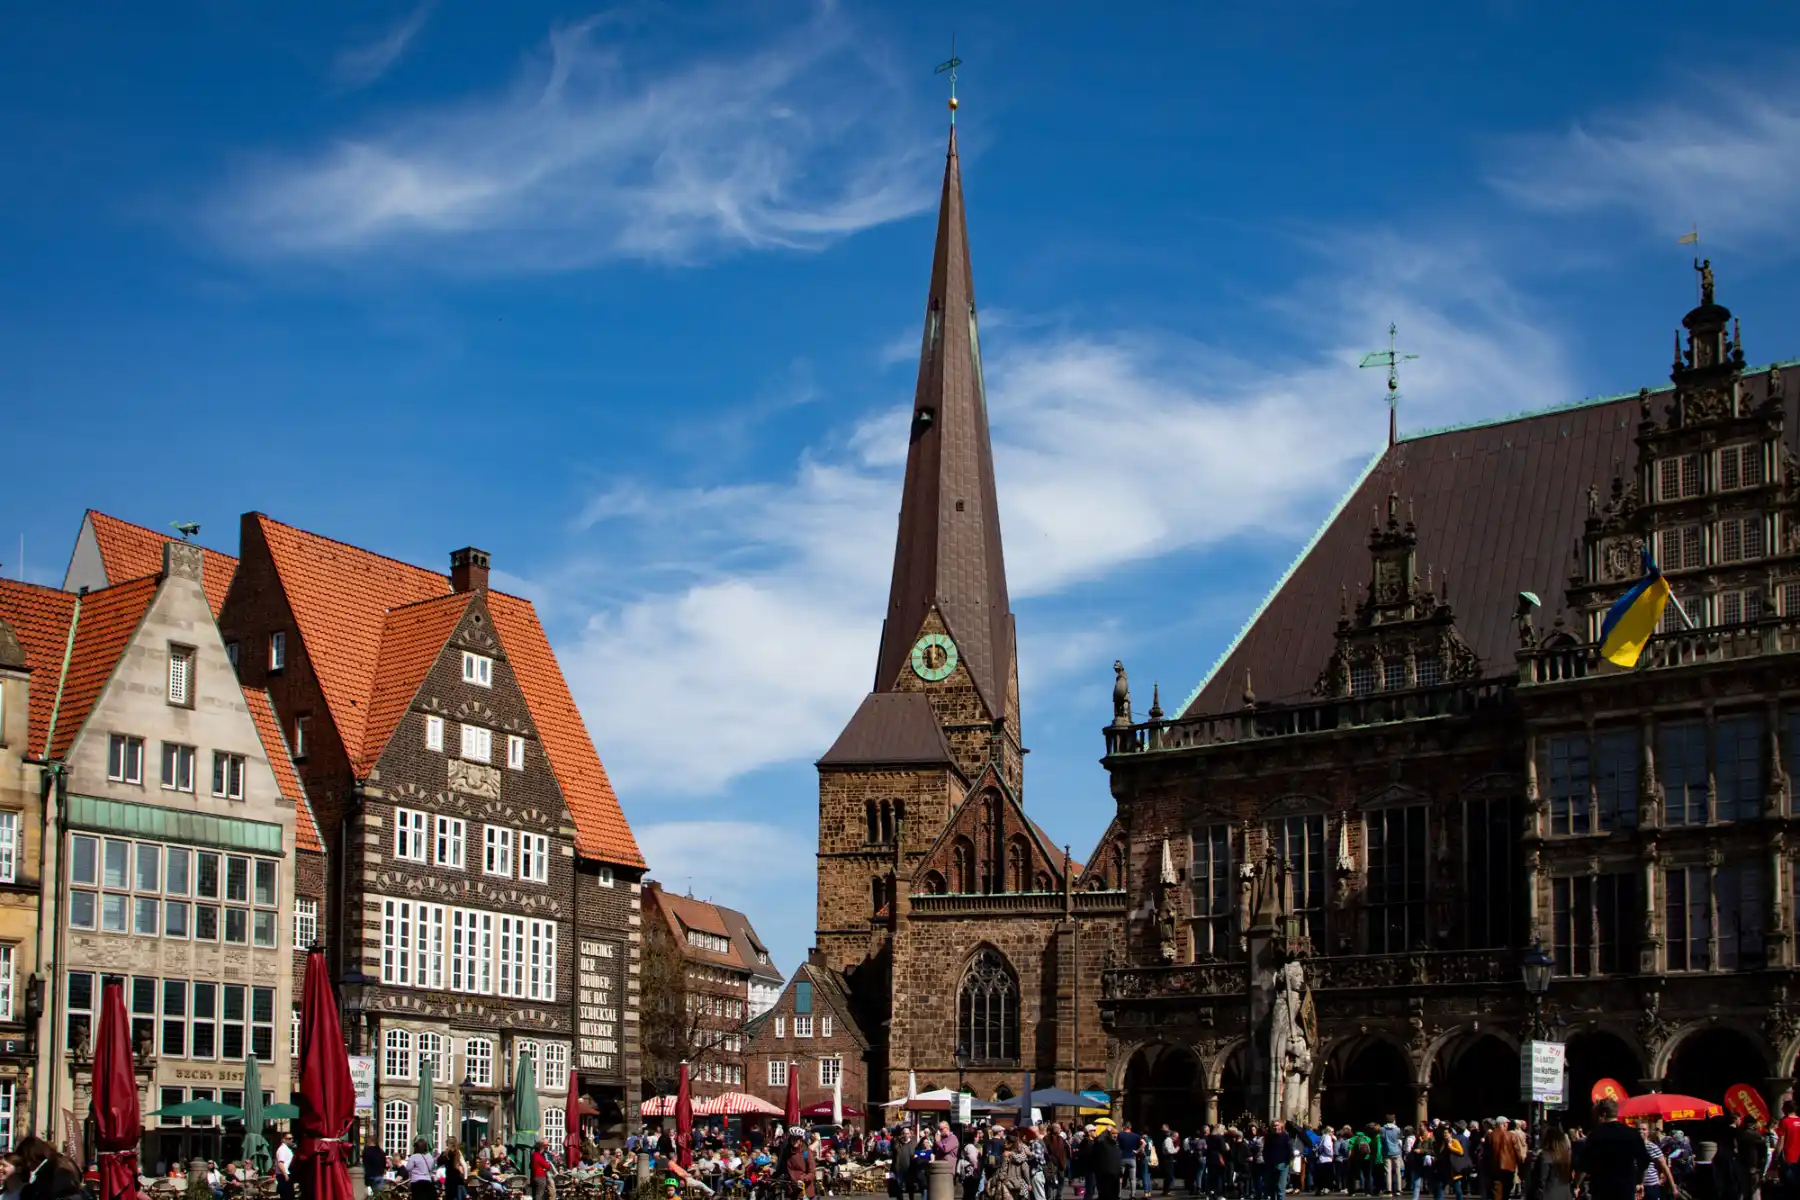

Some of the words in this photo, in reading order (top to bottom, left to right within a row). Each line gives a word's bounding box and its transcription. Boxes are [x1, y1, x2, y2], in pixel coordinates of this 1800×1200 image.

[580, 941, 613, 958] GEDENKE
[580, 957, 595, 972] DER
[580, 989, 592, 1004] DIE
[593, 991, 607, 1005] DAS
[580, 1006, 617, 1022] SCHICKSAL
[580, 1021, 613, 1037] UNSERER
[580, 1037, 618, 1054] TRENNUNG
